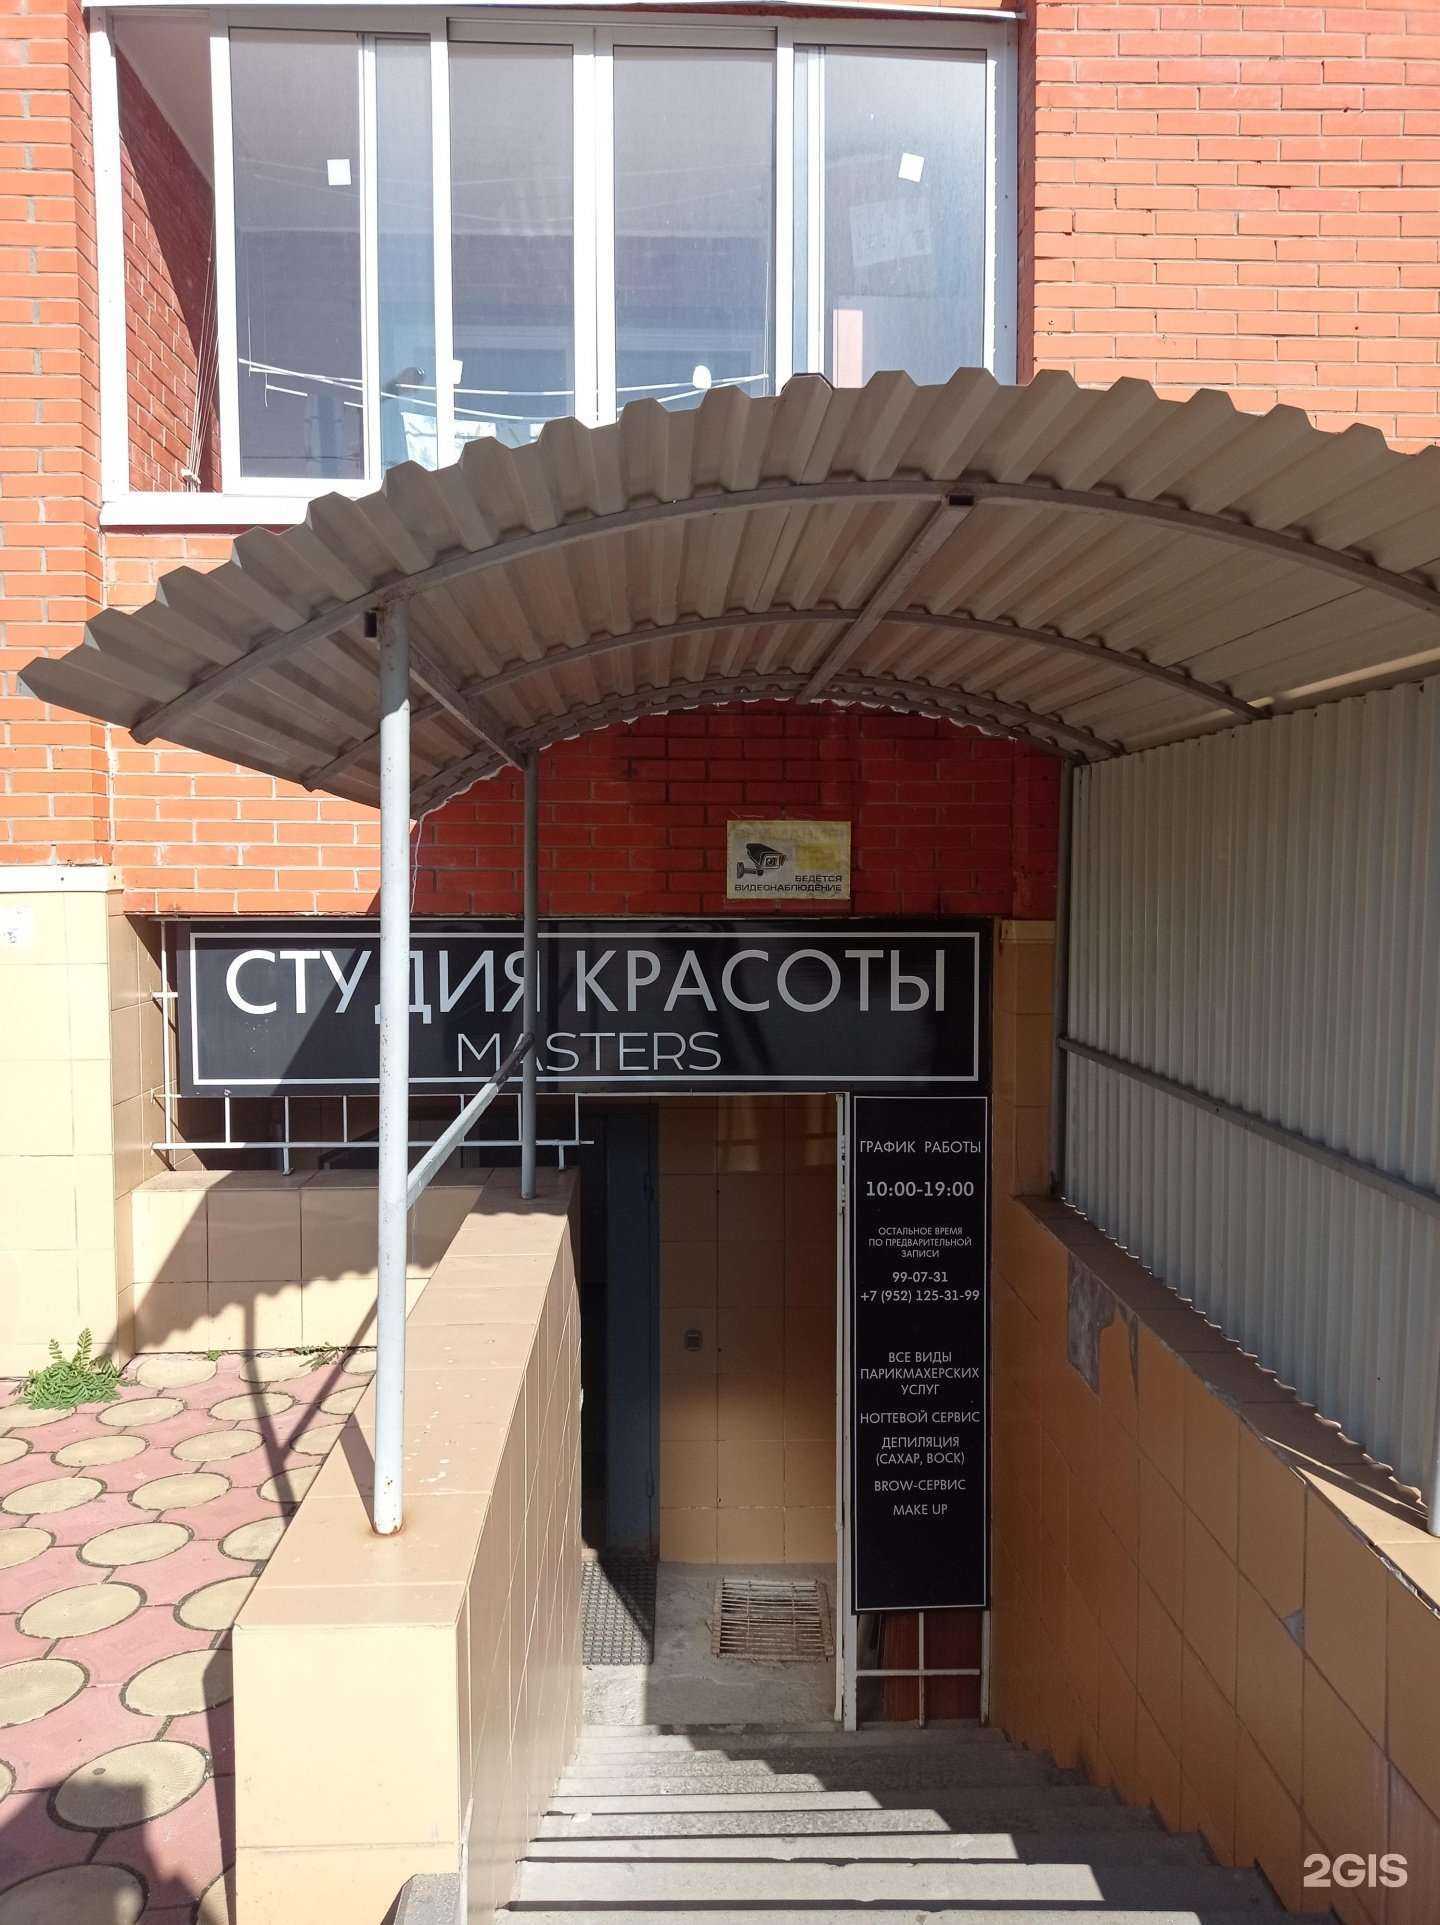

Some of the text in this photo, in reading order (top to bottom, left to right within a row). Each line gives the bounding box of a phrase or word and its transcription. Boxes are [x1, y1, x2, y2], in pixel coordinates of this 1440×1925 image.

[734, 883, 843, 892] ВИДЕОНАБЛЮДЕНИЕ
[576, 948, 945, 1013] КРАСОТЫ
[860, 1140, 981, 1153] ГРАФИК РАБОТЫ
[866, 1181, 975, 1197] 10:00-19:00
[878, 1226, 963, 1236] ОСТАЛЬНОЕ ВРЕМЯ
[868, 1236, 972, 1248] ПО ПРЕДВАРИТЕЛЬНОЙ
[900, 1249, 940, 1258] ЗАПИСИ
[892, 1271, 949, 1283] 99-07-31
[860, 1289, 980, 1304] +7 (952) 125-31-99
[888, 1351, 952, 1364] ВСЕ ВИДЫ
[860, 1367, 980, 1380] ПАРИКМАХЕРСКИХ
[901, 1383, 941, 1395] УСЛУГ
[860, 1409, 981, 1424] НОГТЕВОЙ СЕРВИС
[881, 1436, 960, 1450] ДЕПИЛЯЦИЯ
[876, 1452, 965, 1466] (САХАР, ВОСК)
[893, 1503, 948, 1515] MAKE UP
